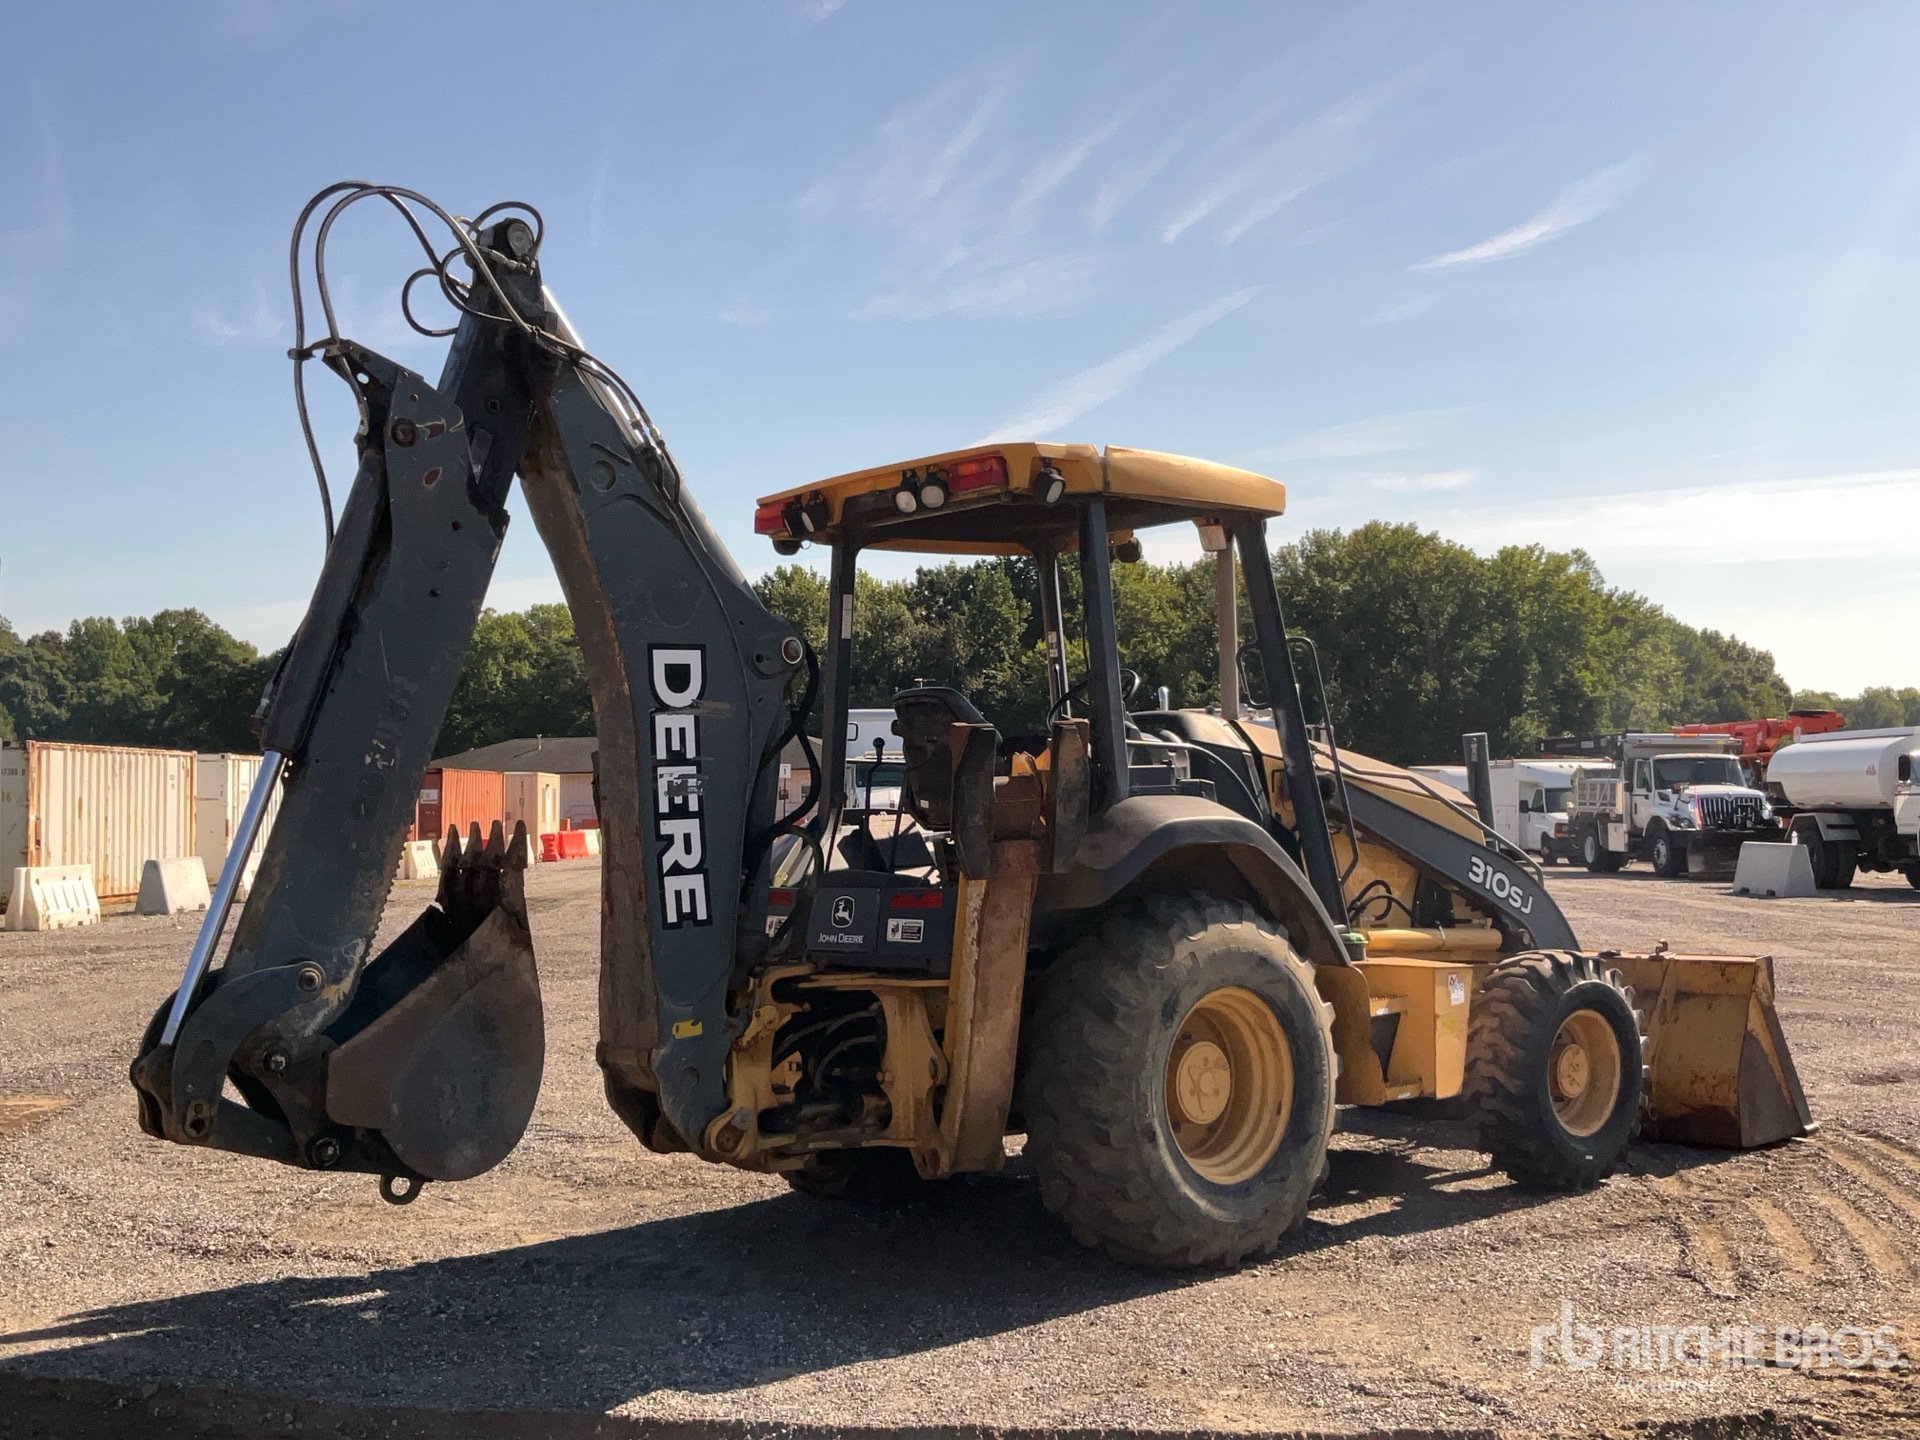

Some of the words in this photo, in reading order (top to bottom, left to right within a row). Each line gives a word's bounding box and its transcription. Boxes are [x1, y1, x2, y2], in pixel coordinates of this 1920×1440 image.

[652, 649, 708, 924] DEERE
[1468, 856, 1533, 914] 310SJ
[818, 932, 837, 943] JOHN
[838, 933, 864, 944] DEERE
